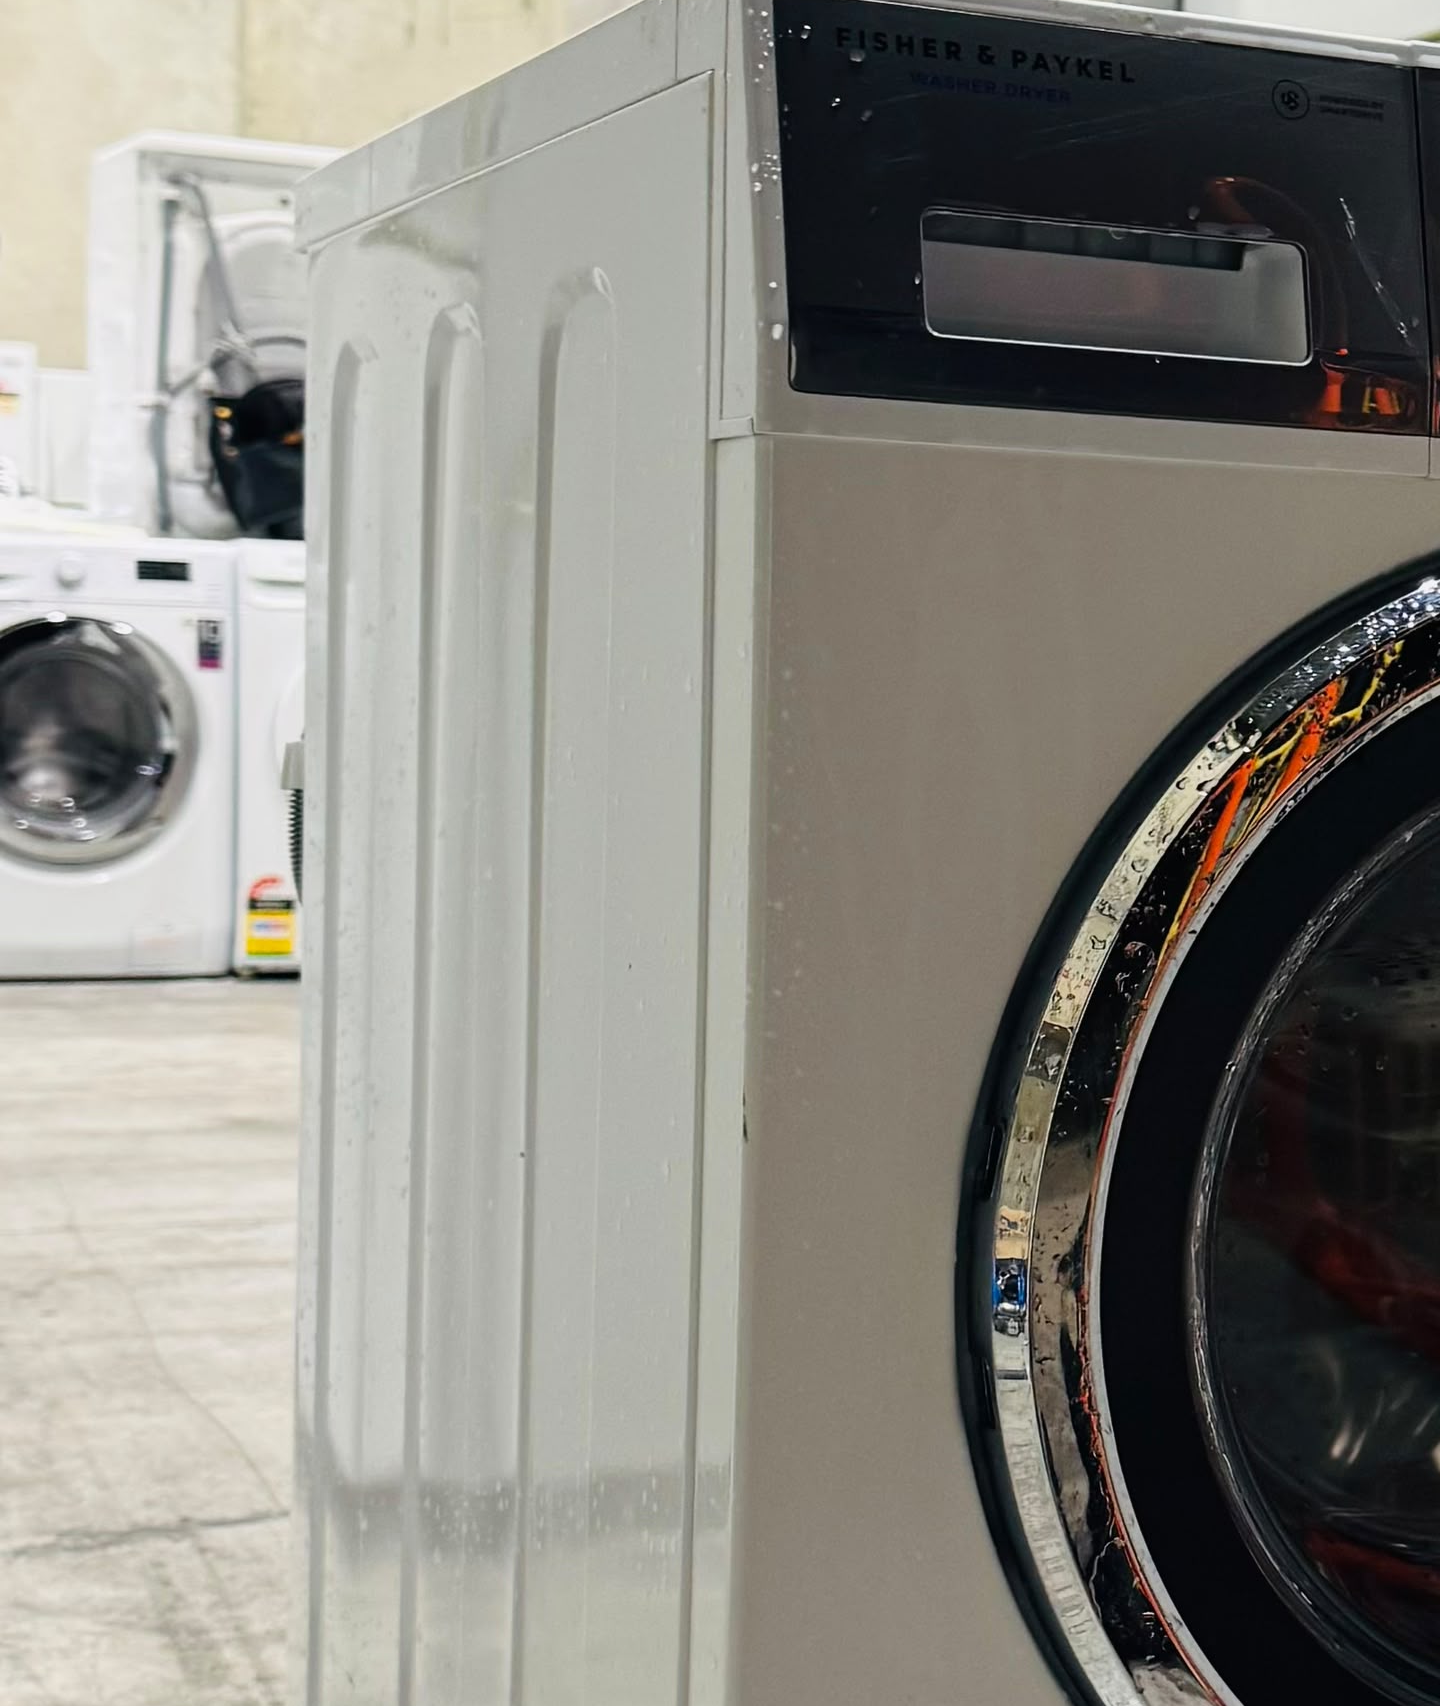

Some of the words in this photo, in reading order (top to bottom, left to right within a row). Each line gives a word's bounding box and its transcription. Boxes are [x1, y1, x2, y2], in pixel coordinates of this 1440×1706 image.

[836, 27, 962, 62] FISHER
[976, 44, 996, 65] &
[1011, 49, 1136, 83] PAYKEL
[908, 72, 996, 94] WASHER
[1000, 81, 1071, 104] DRYER
